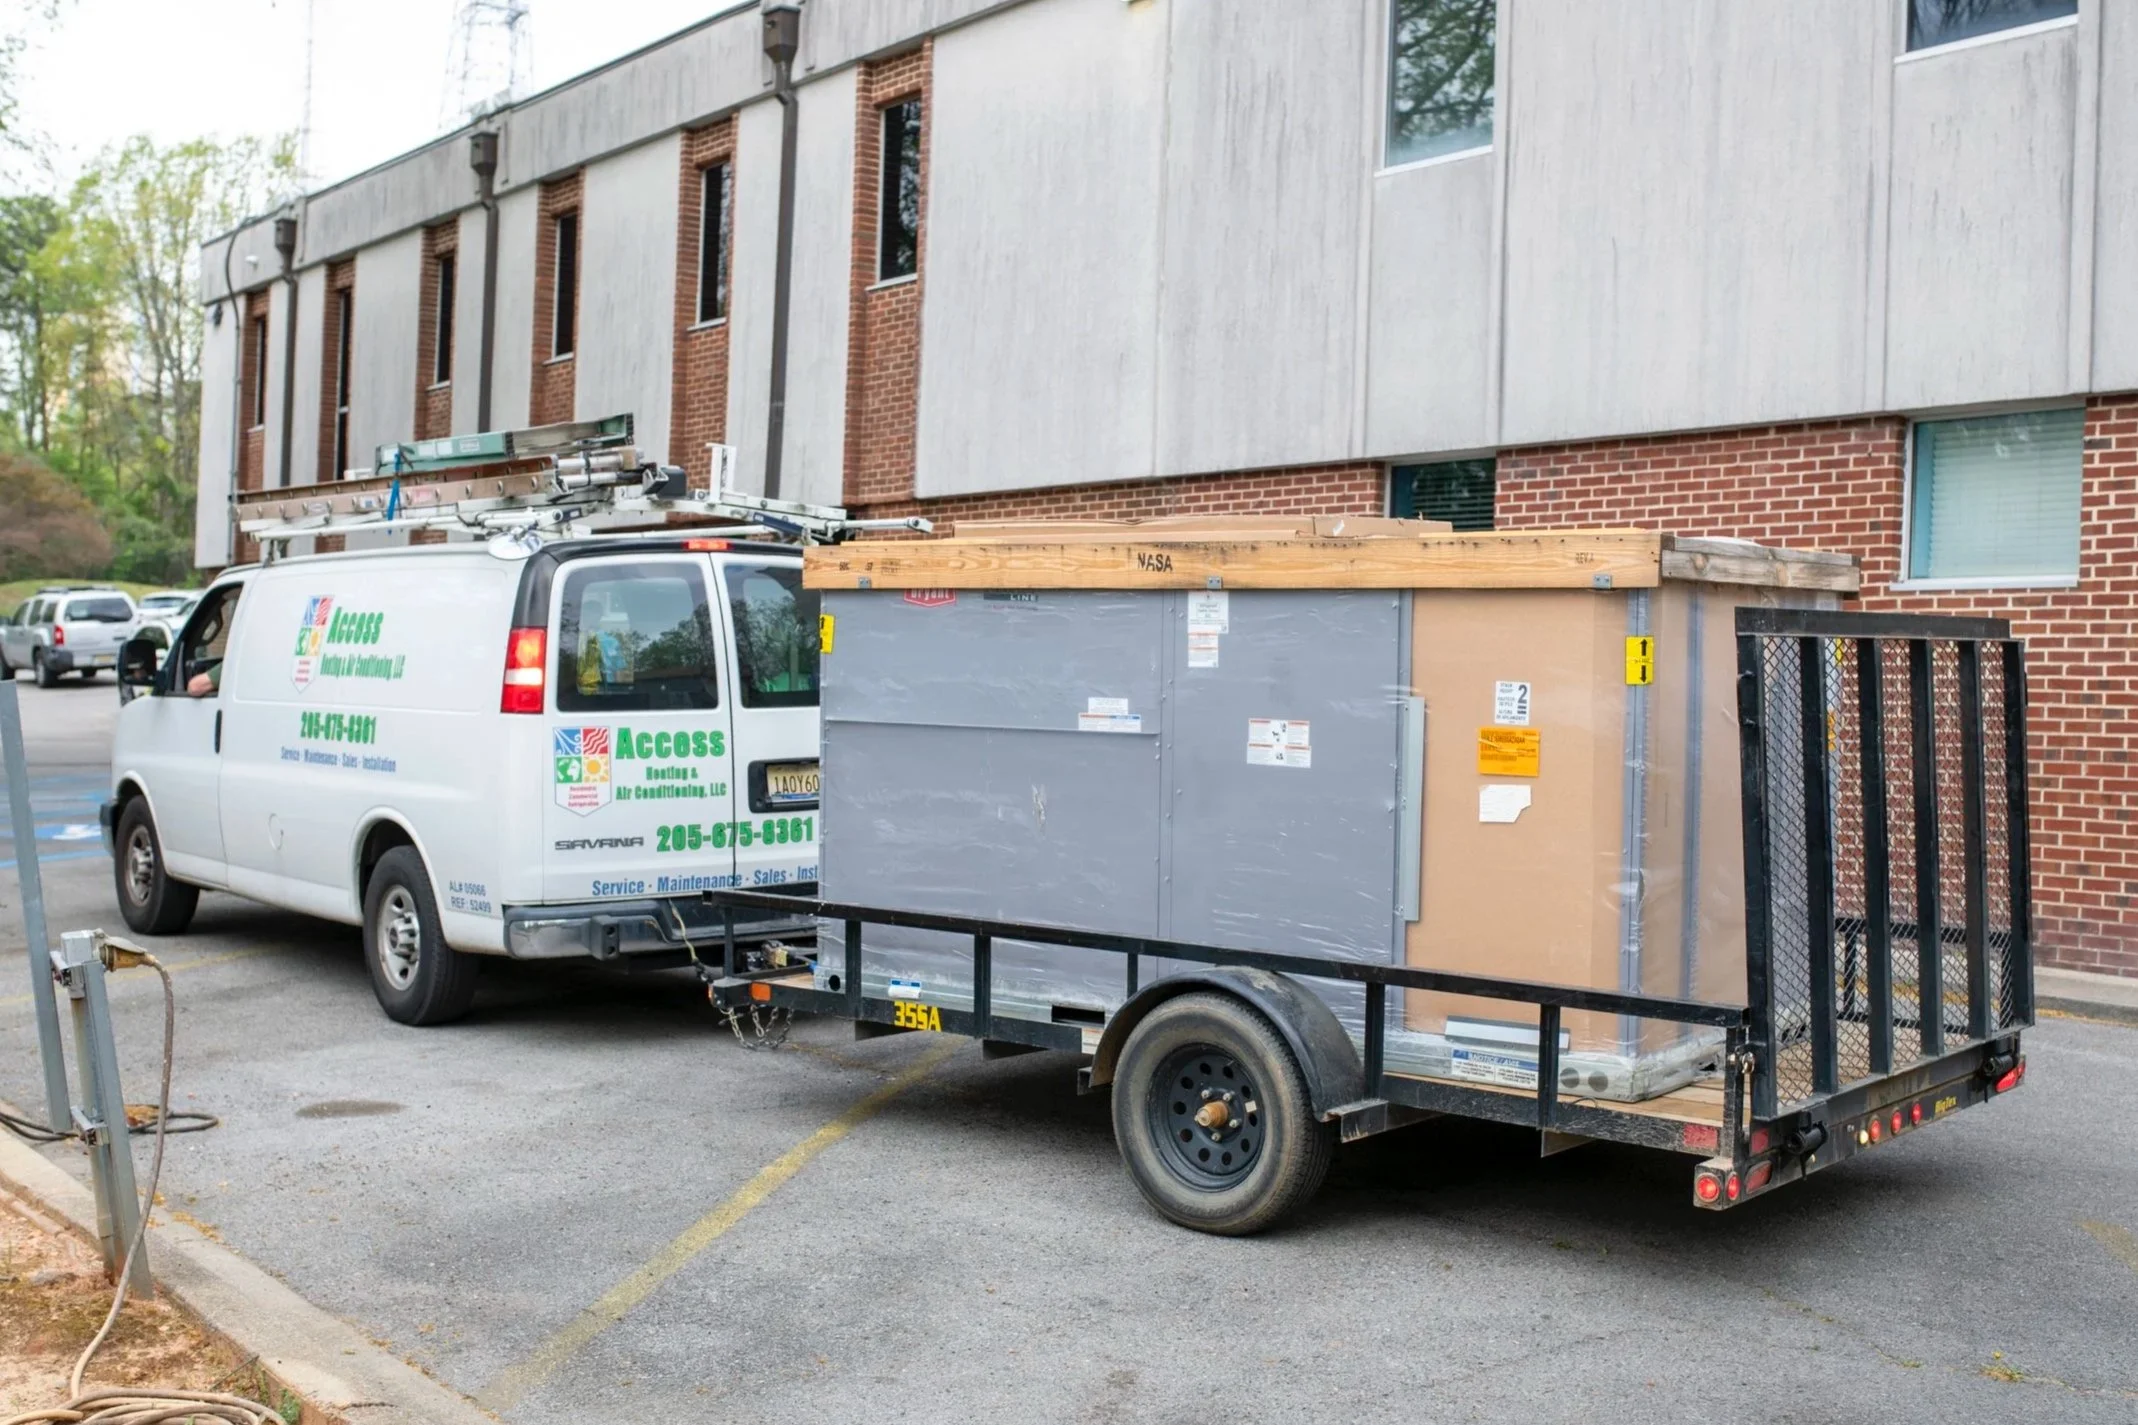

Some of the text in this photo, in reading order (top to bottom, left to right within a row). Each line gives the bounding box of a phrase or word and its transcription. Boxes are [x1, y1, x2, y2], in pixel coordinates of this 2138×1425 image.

[1137, 552, 1173, 572] NASA
[1010, 593, 1037, 602] LINE
[1517, 684, 1527, 704] 2
[646, 766, 698, 780] Heating &
[616, 786, 632, 800] Air
[710, 782, 727, 796] LLC
[555, 837, 644, 850] SAVANA
[656, 816, 813, 852] 205-675-8361
[592, 879, 645, 896] Service
[657, 873, 742, 892] Maintenance
[754, 868, 787, 885] Sales
